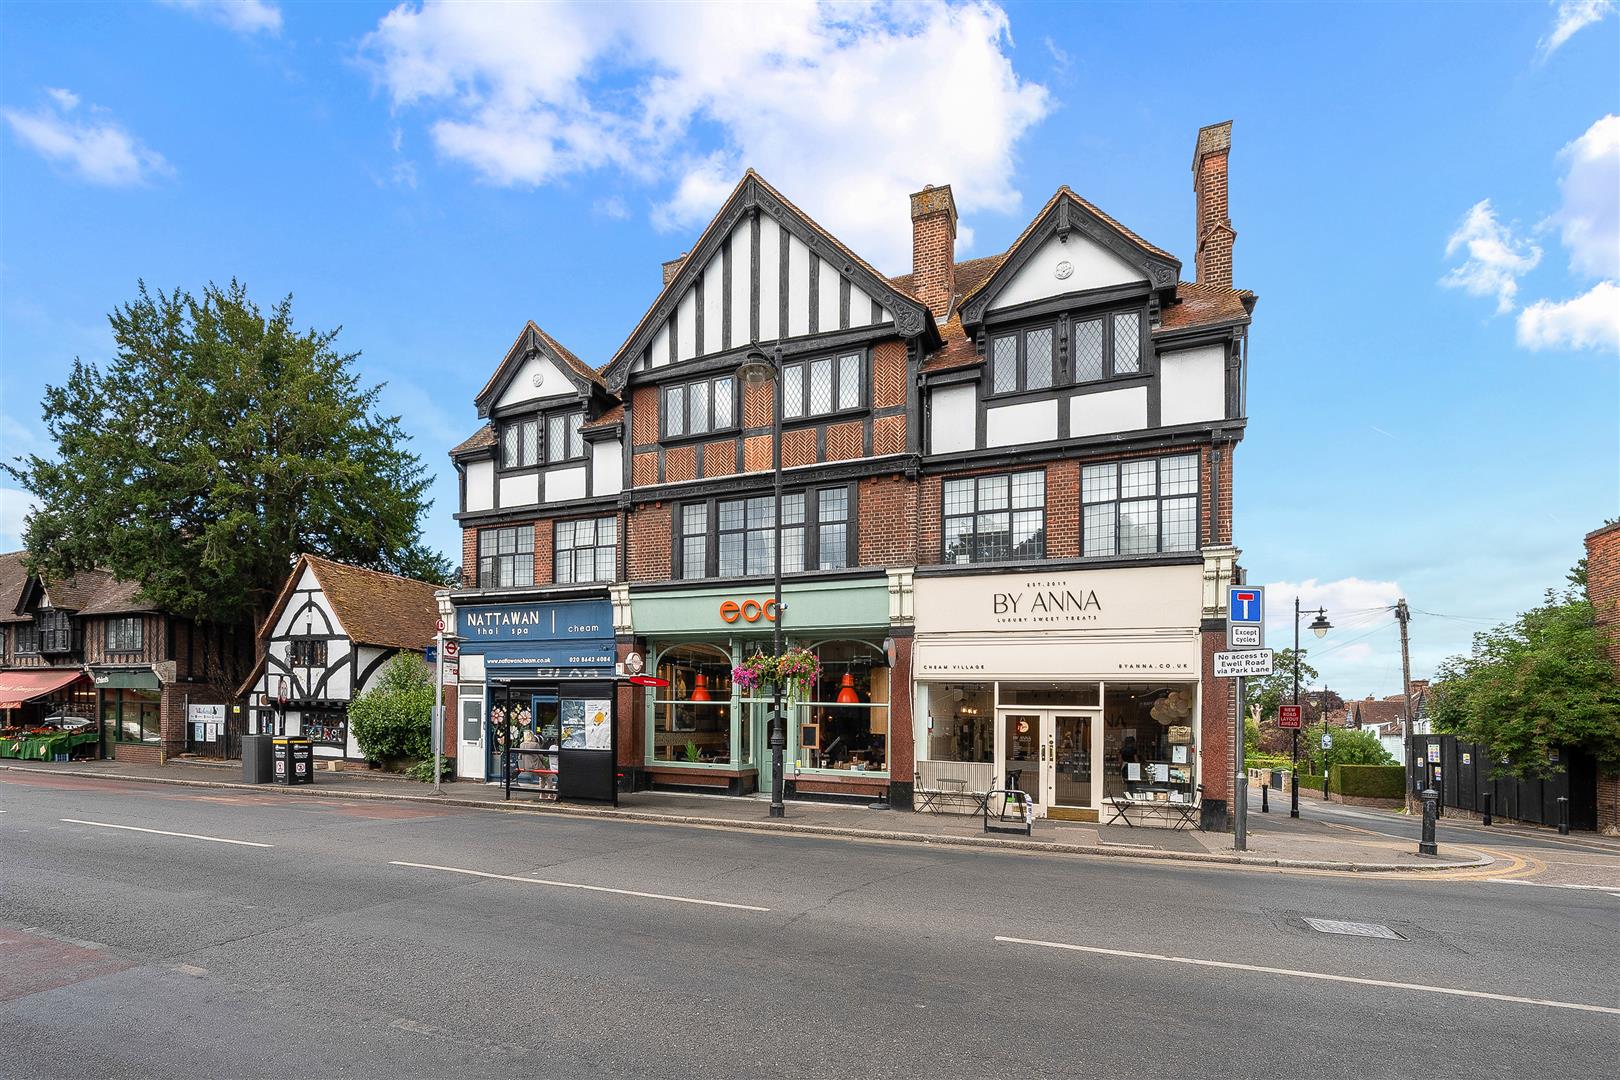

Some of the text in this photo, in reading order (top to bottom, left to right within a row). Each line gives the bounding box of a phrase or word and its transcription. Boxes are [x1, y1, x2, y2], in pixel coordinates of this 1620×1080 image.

[994, 590, 1101, 614] BY ANNA
[467, 611, 539, 626] NATTAWAN
[478, 627, 528, 636] thai spa
[568, 624, 599, 632] cheam
